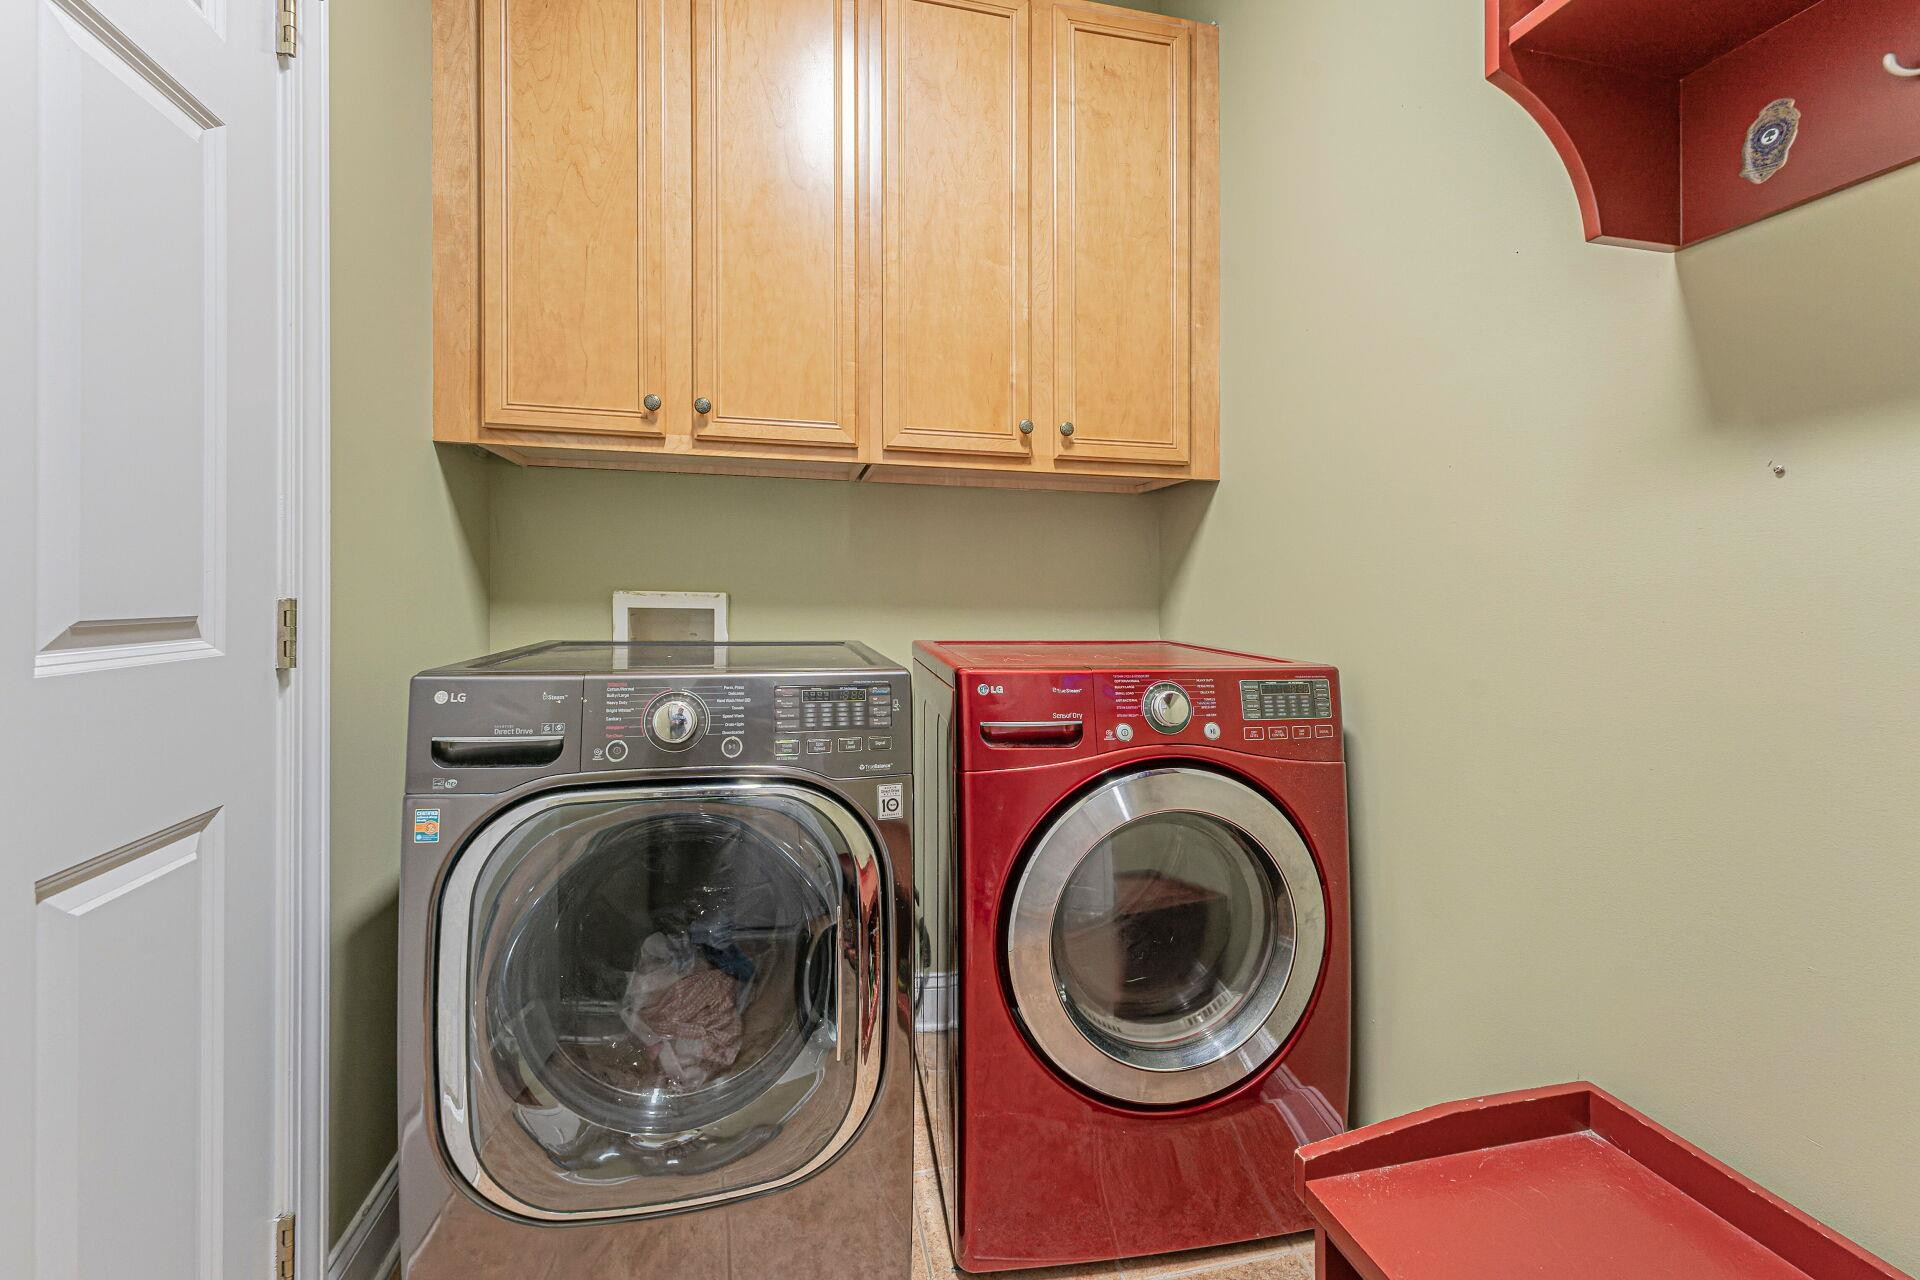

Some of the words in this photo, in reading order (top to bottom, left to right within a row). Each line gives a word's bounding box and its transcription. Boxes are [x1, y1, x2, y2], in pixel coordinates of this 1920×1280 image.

[990, 685, 1004, 694] LG
[450, 692, 467, 703] LG
[1072, 712, 1083, 720] Dry
[515, 727, 534, 735] Drive
[882, 798, 899, 813] 10
